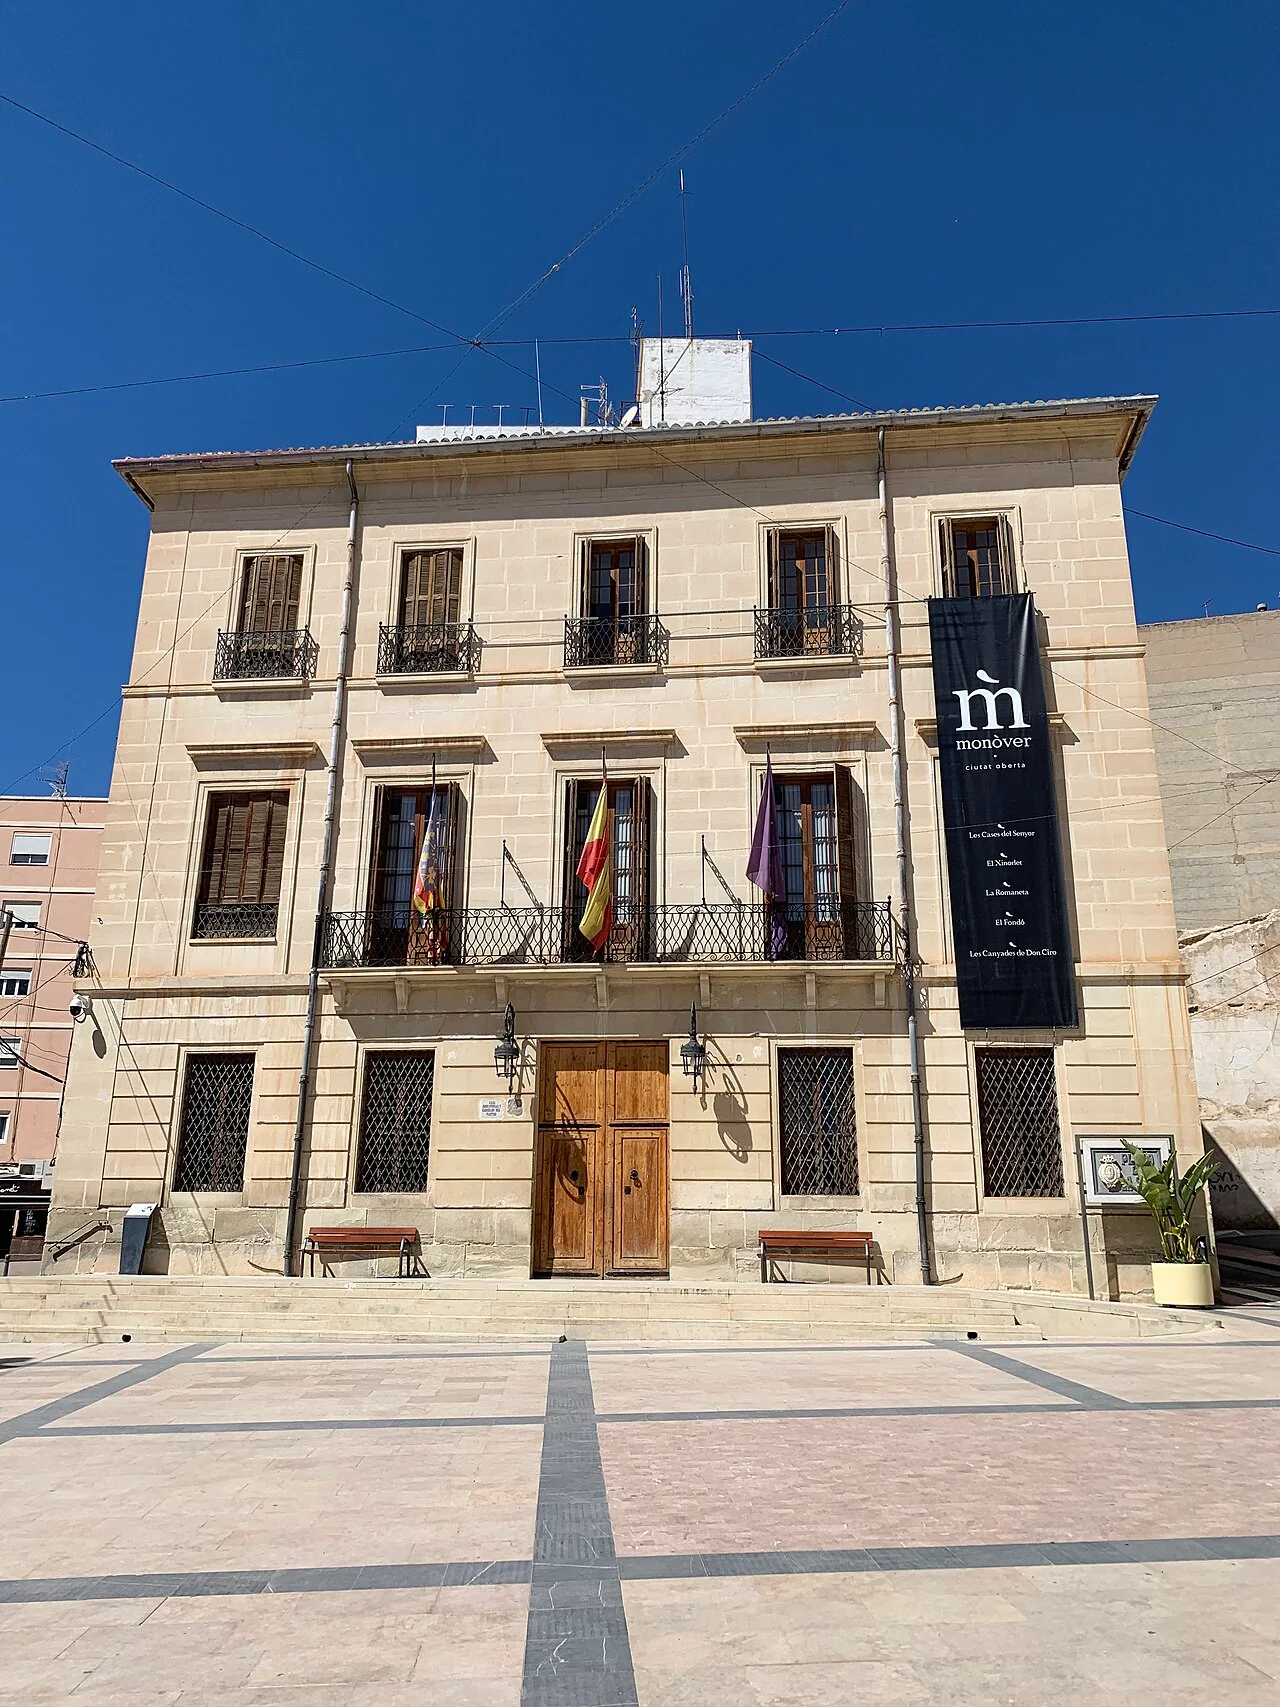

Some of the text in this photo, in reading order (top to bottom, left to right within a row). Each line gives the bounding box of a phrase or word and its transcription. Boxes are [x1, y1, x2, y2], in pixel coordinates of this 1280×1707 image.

[956, 734, 1032, 751] monòver
[1012, 830, 1036, 839] Senyor
[969, 948, 1057, 959] Les Canyades de Don Ciro
